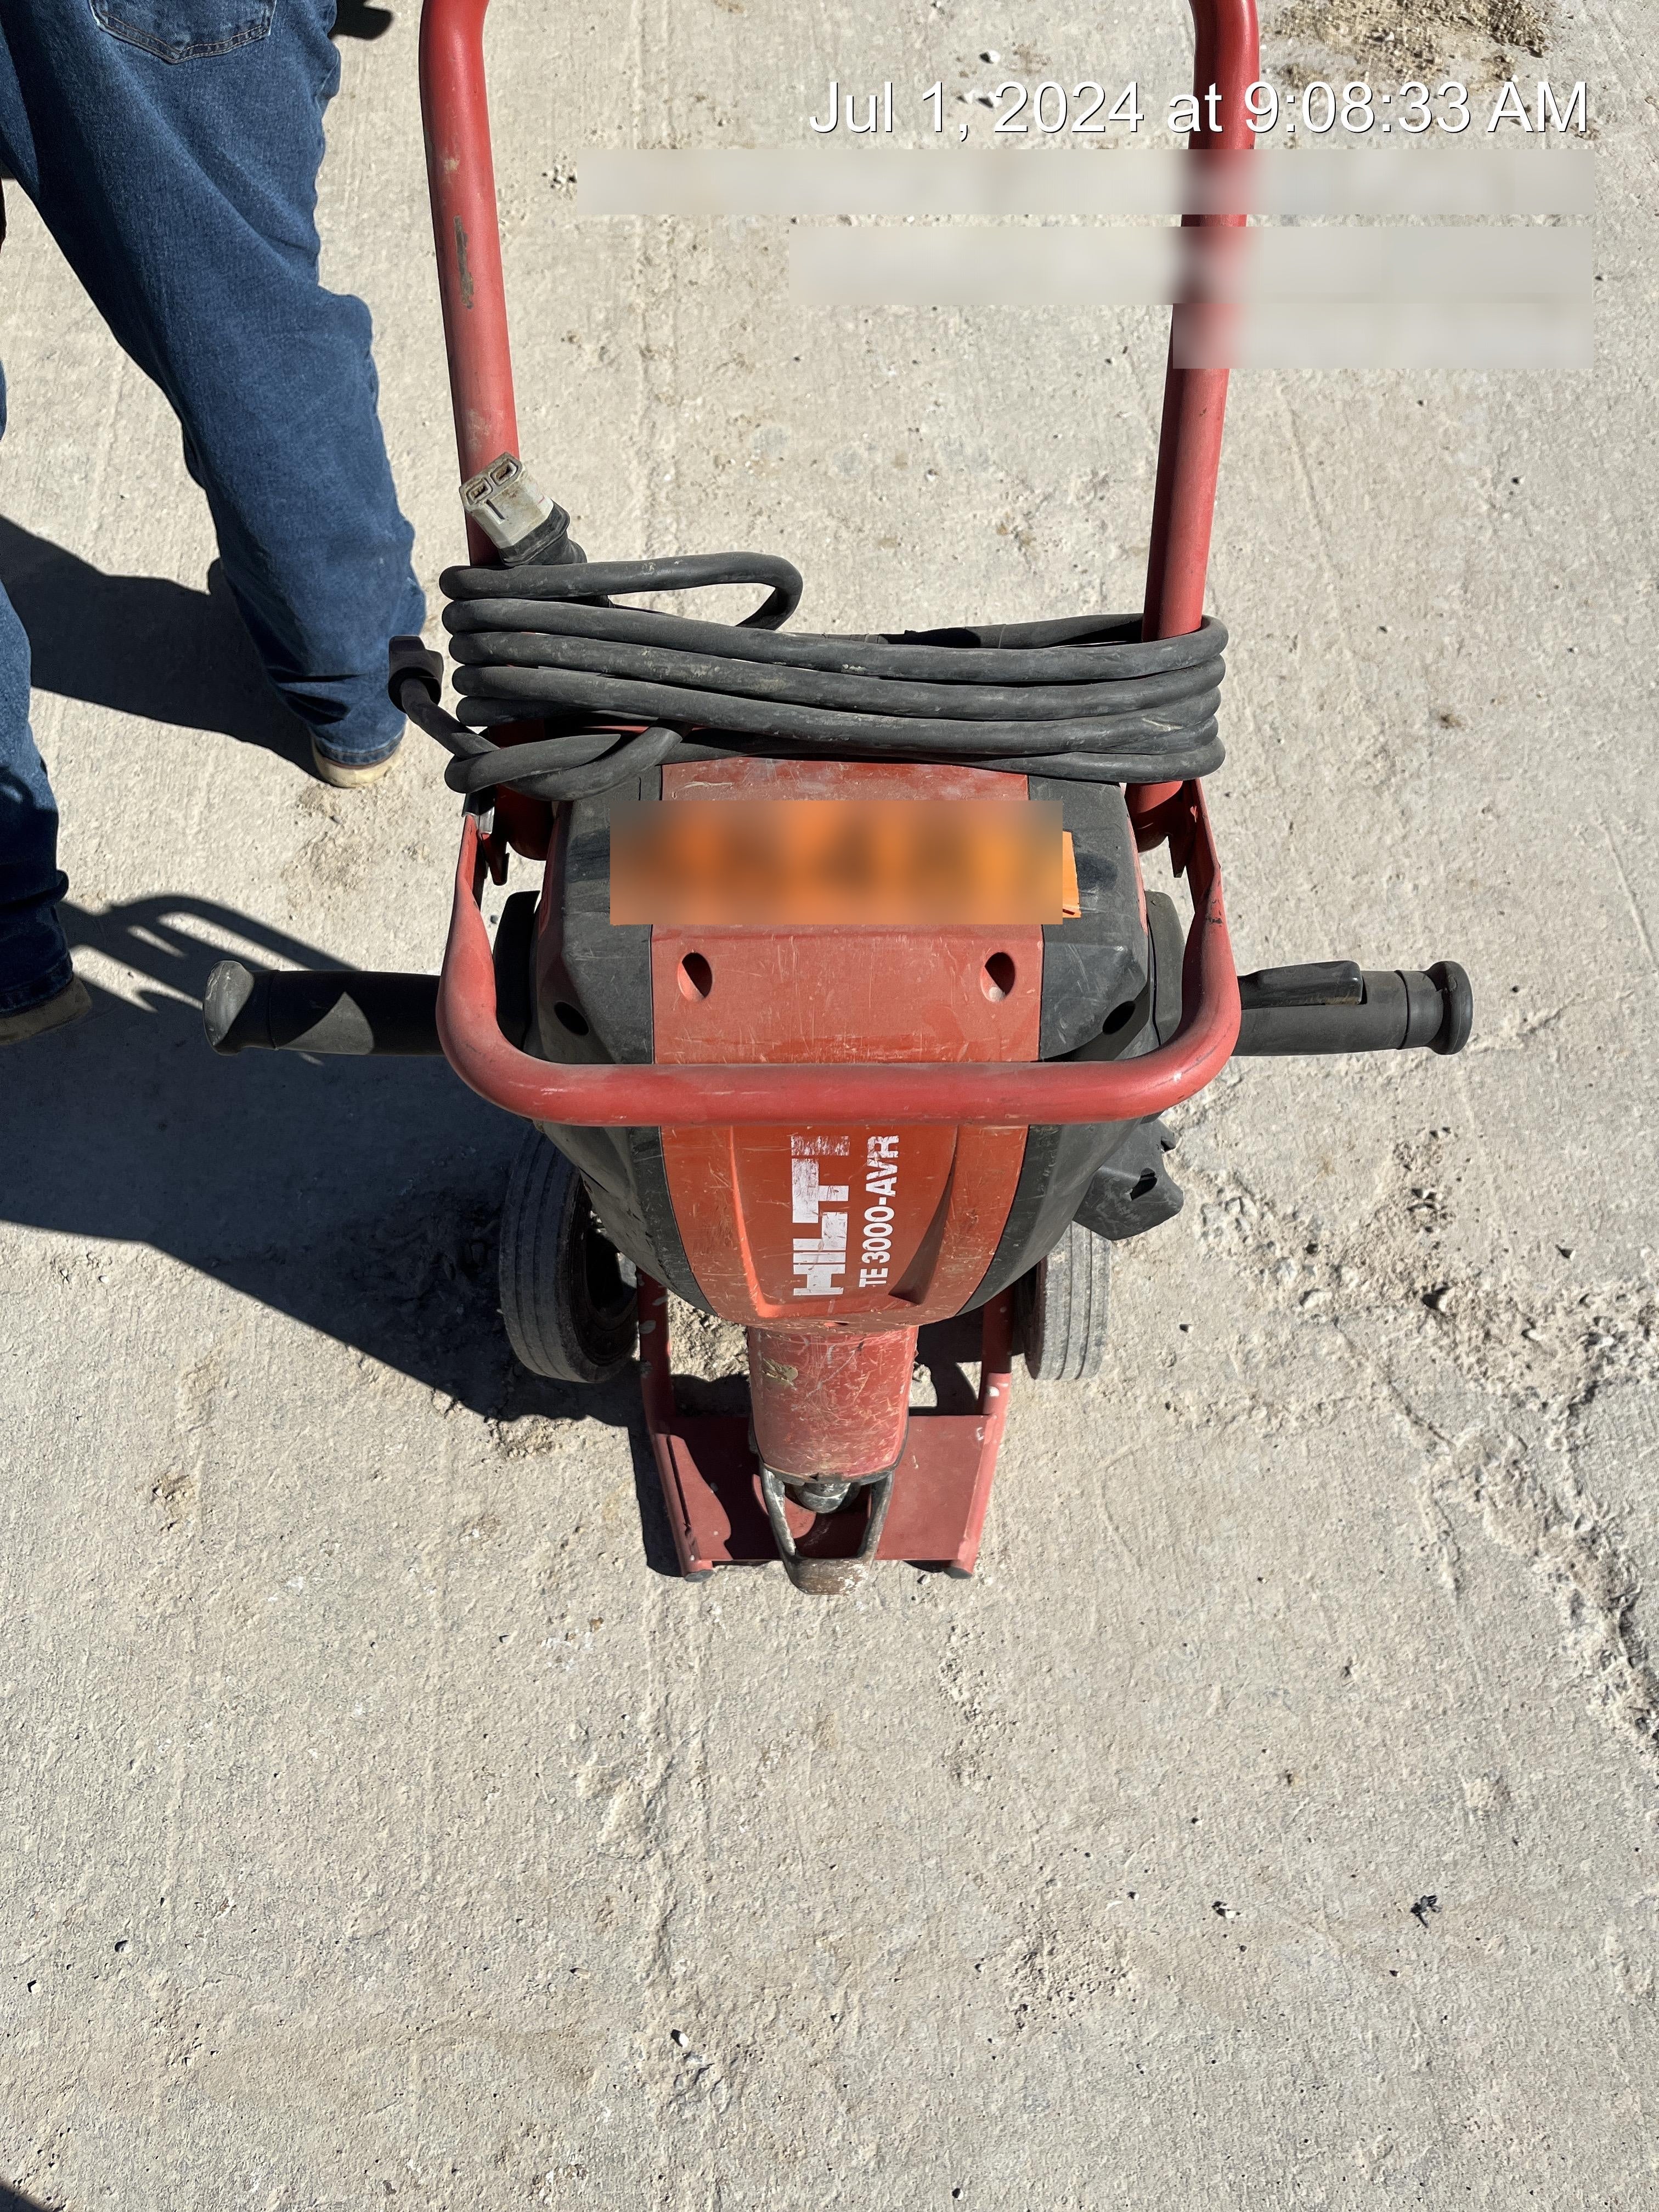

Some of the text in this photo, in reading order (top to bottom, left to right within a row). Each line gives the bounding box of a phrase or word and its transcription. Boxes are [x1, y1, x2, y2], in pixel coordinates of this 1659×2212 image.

[791, 1136, 850, 1296] HILTI
[859, 1135, 900, 1288] TE 3000-AVR
